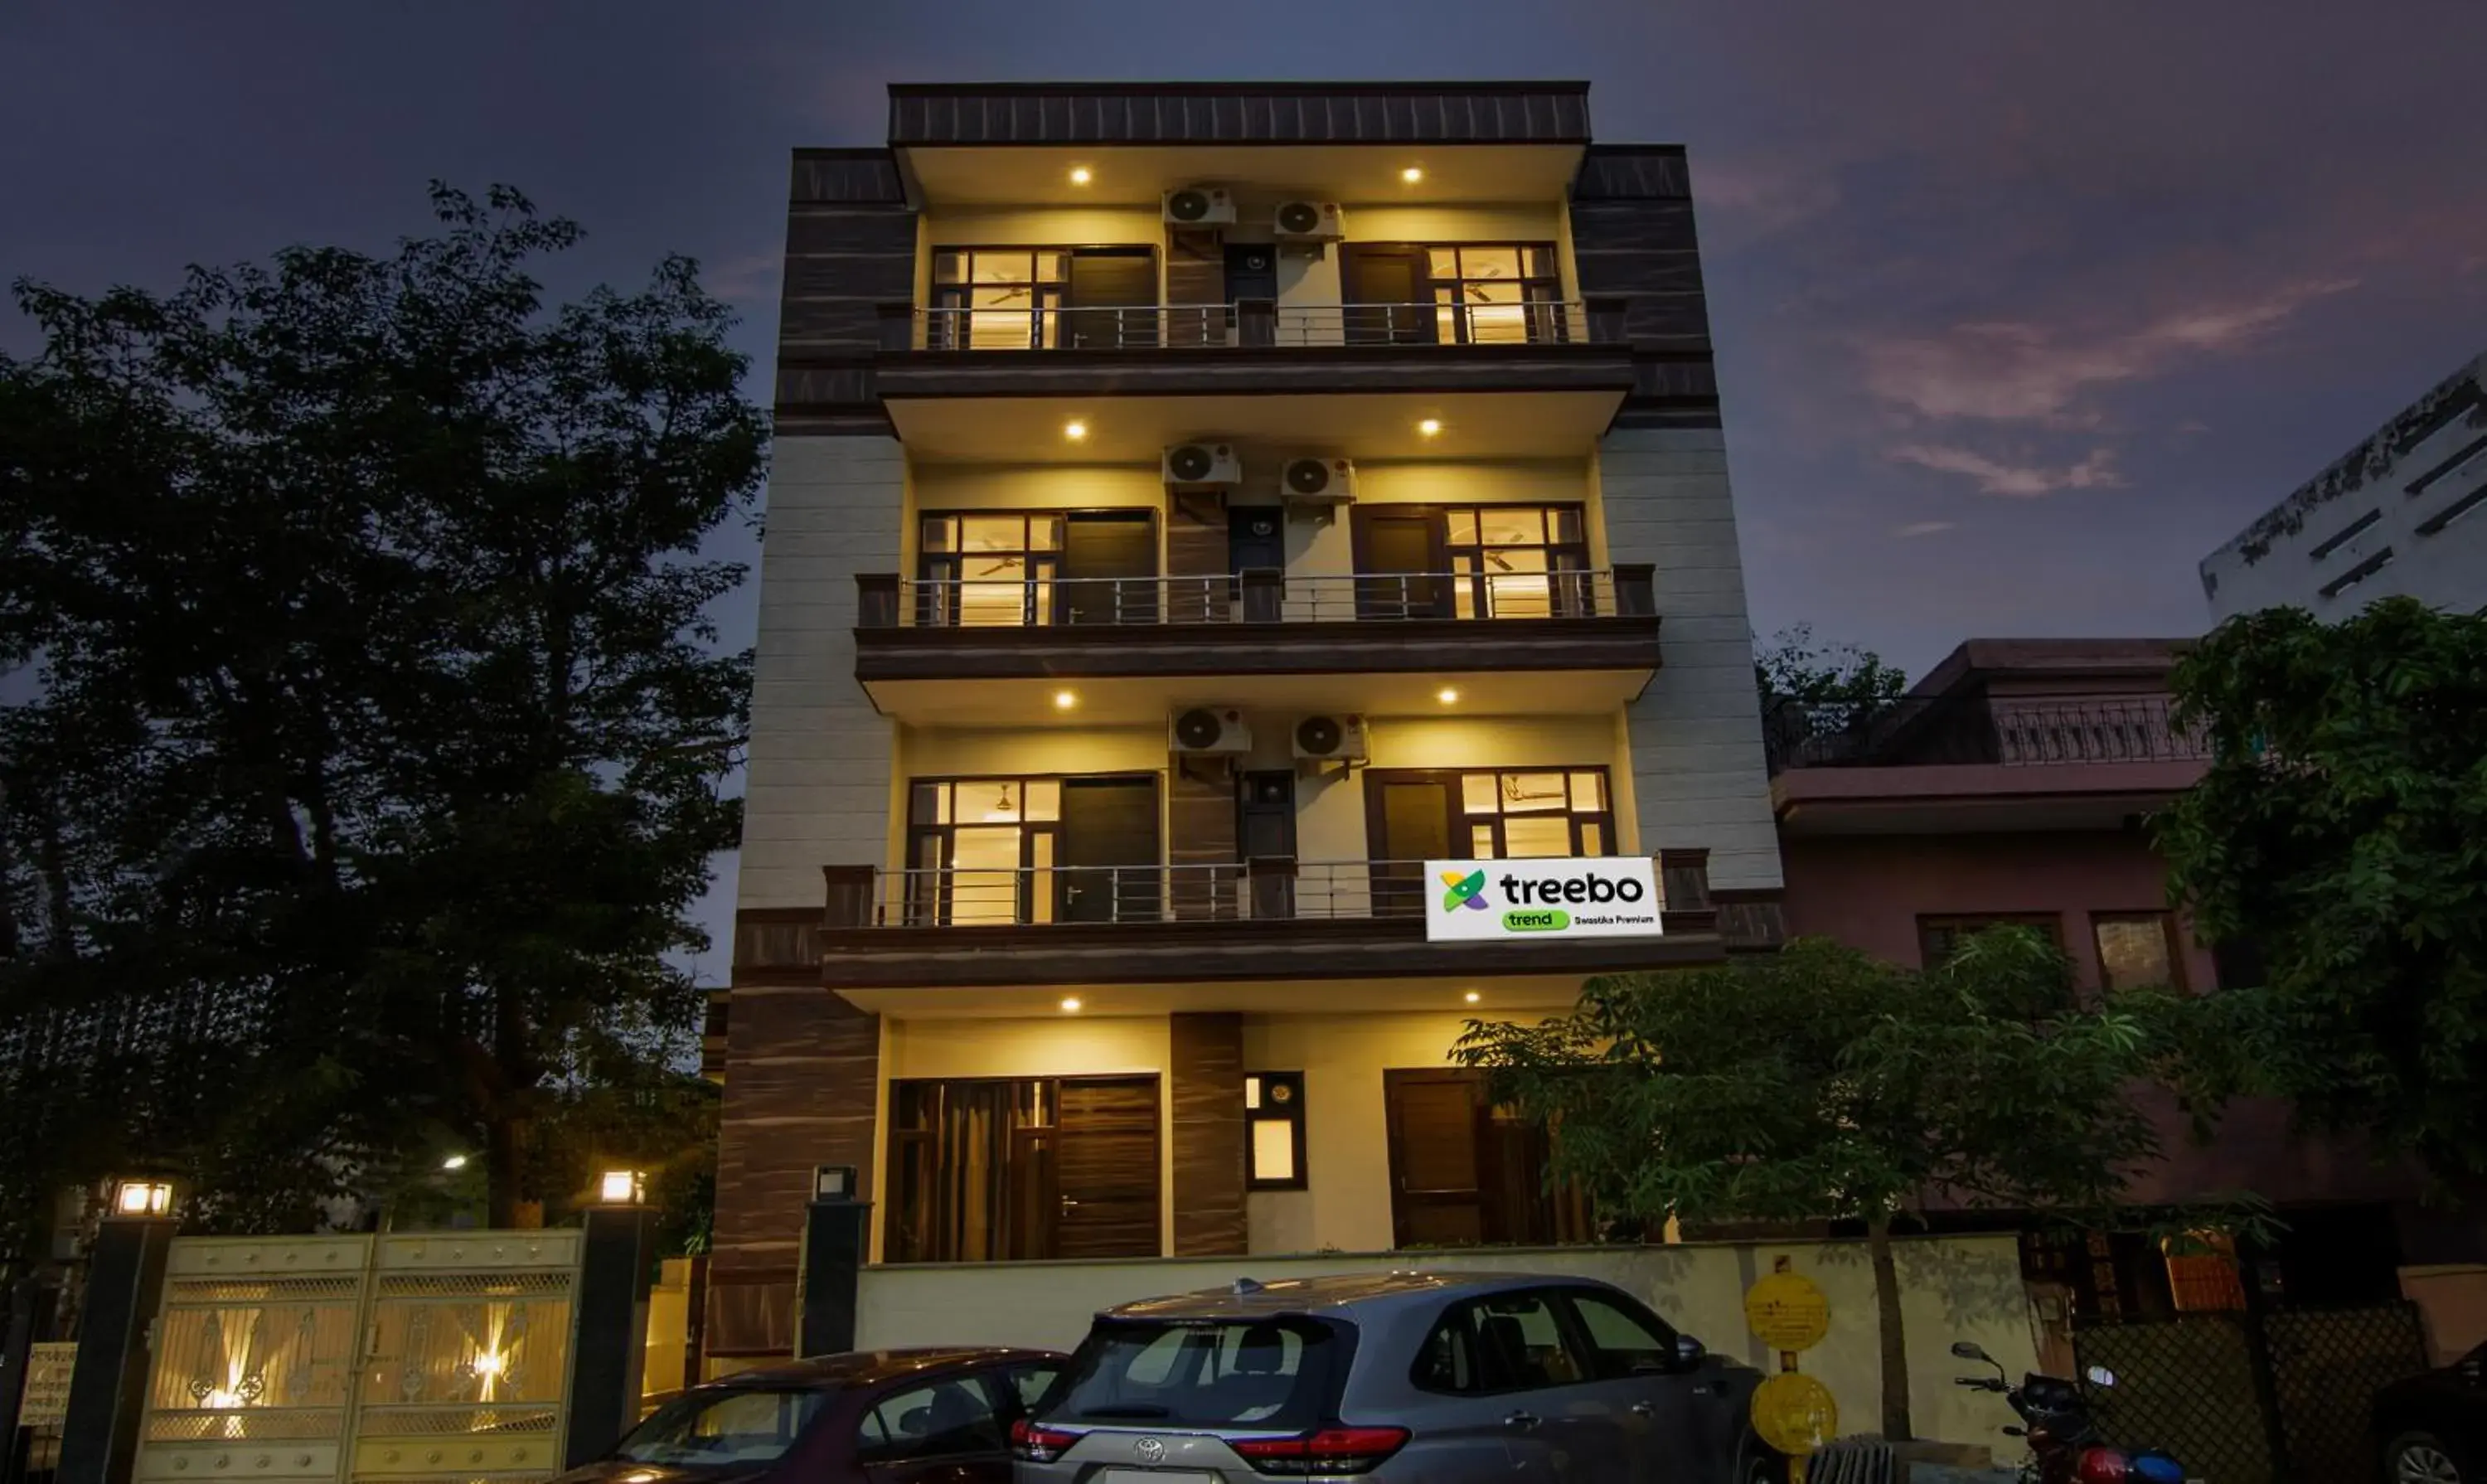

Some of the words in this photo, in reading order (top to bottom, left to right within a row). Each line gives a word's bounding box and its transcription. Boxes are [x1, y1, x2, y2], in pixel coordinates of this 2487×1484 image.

[1500, 873, 1644, 904] treebo
[1509, 913, 1553, 926] trend
[1574, 915, 1614, 924] Swastika
[1616, 914, 1655, 924] Premium
